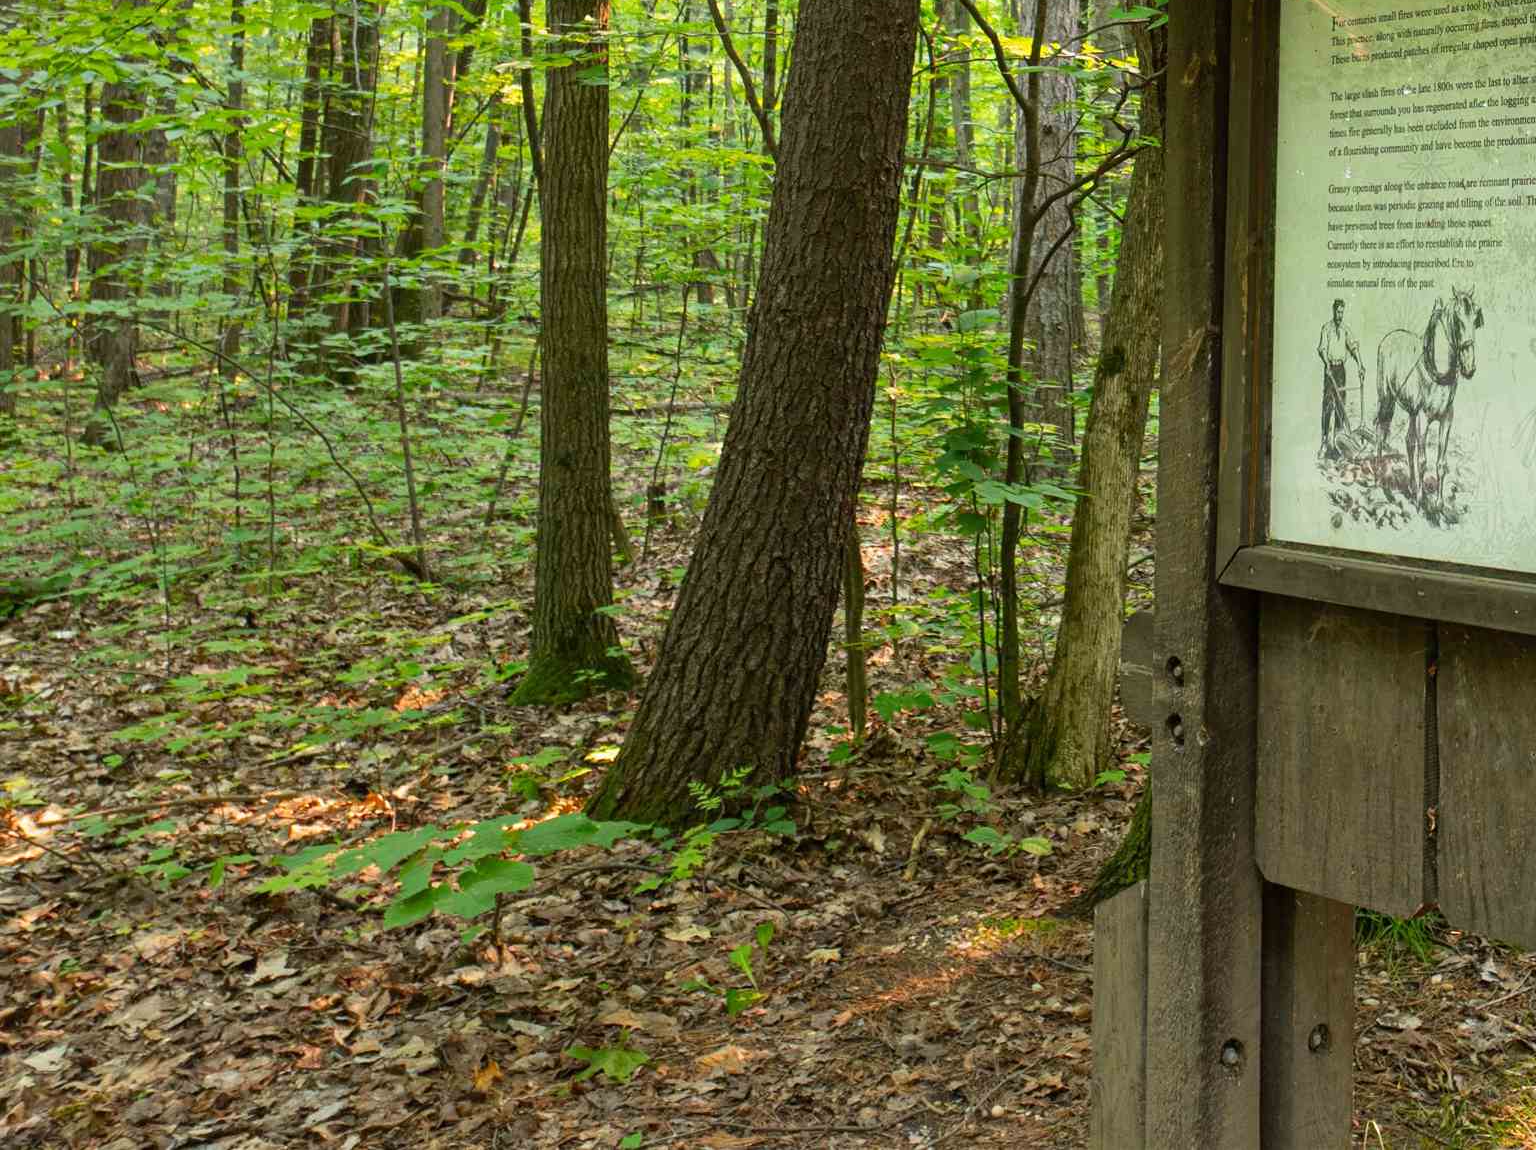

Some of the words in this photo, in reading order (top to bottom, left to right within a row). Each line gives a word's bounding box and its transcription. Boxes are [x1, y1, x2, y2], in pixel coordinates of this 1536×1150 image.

[1414, 9, 1430, 17] were
[1433, 3, 1449, 15] used
[1452, 5, 1459, 13] as
[1466, 0, 1480, 11] tool
[1482, 0, 1490, 11] by
[1502, 13, 1526, 27] shaped
[1371, 47, 1402, 63] produced
[1472, 37, 1497, 51] shaped
[1500, 38, 1518, 49] open
[1331, 91, 1342, 101] The
[1434, 81, 1454, 92] 1800s
[1456, 82, 1472, 90] were
[1474, 78, 1485, 88] the
[1488, 77, 1500, 87] last
[1502, 77, 1510, 86] to
[1398, 106, 1410, 116] you
[1412, 103, 1424, 112] has
[1487, 96, 1498, 107] the
[1501, 95, 1529, 108] logging
[1425, 119, 1456, 131] excluded
[1459, 118, 1476, 128] from
[1478, 117, 1489, 127] the
[1328, 146, 1336, 156] of
[1420, 140, 1434, 150] and
[1454, 138, 1482, 148] become
[1484, 136, 1495, 147] the
[1446, 197, 1458, 208] and
[1416, 240, 1424, 248] to
[1362, 258, 1370, 270] by
[1414, 257, 1450, 270] prescribed
[1466, 258, 1474, 267] to
[1398, 278, 1405, 288] of
[1406, 278, 1417, 288] the
